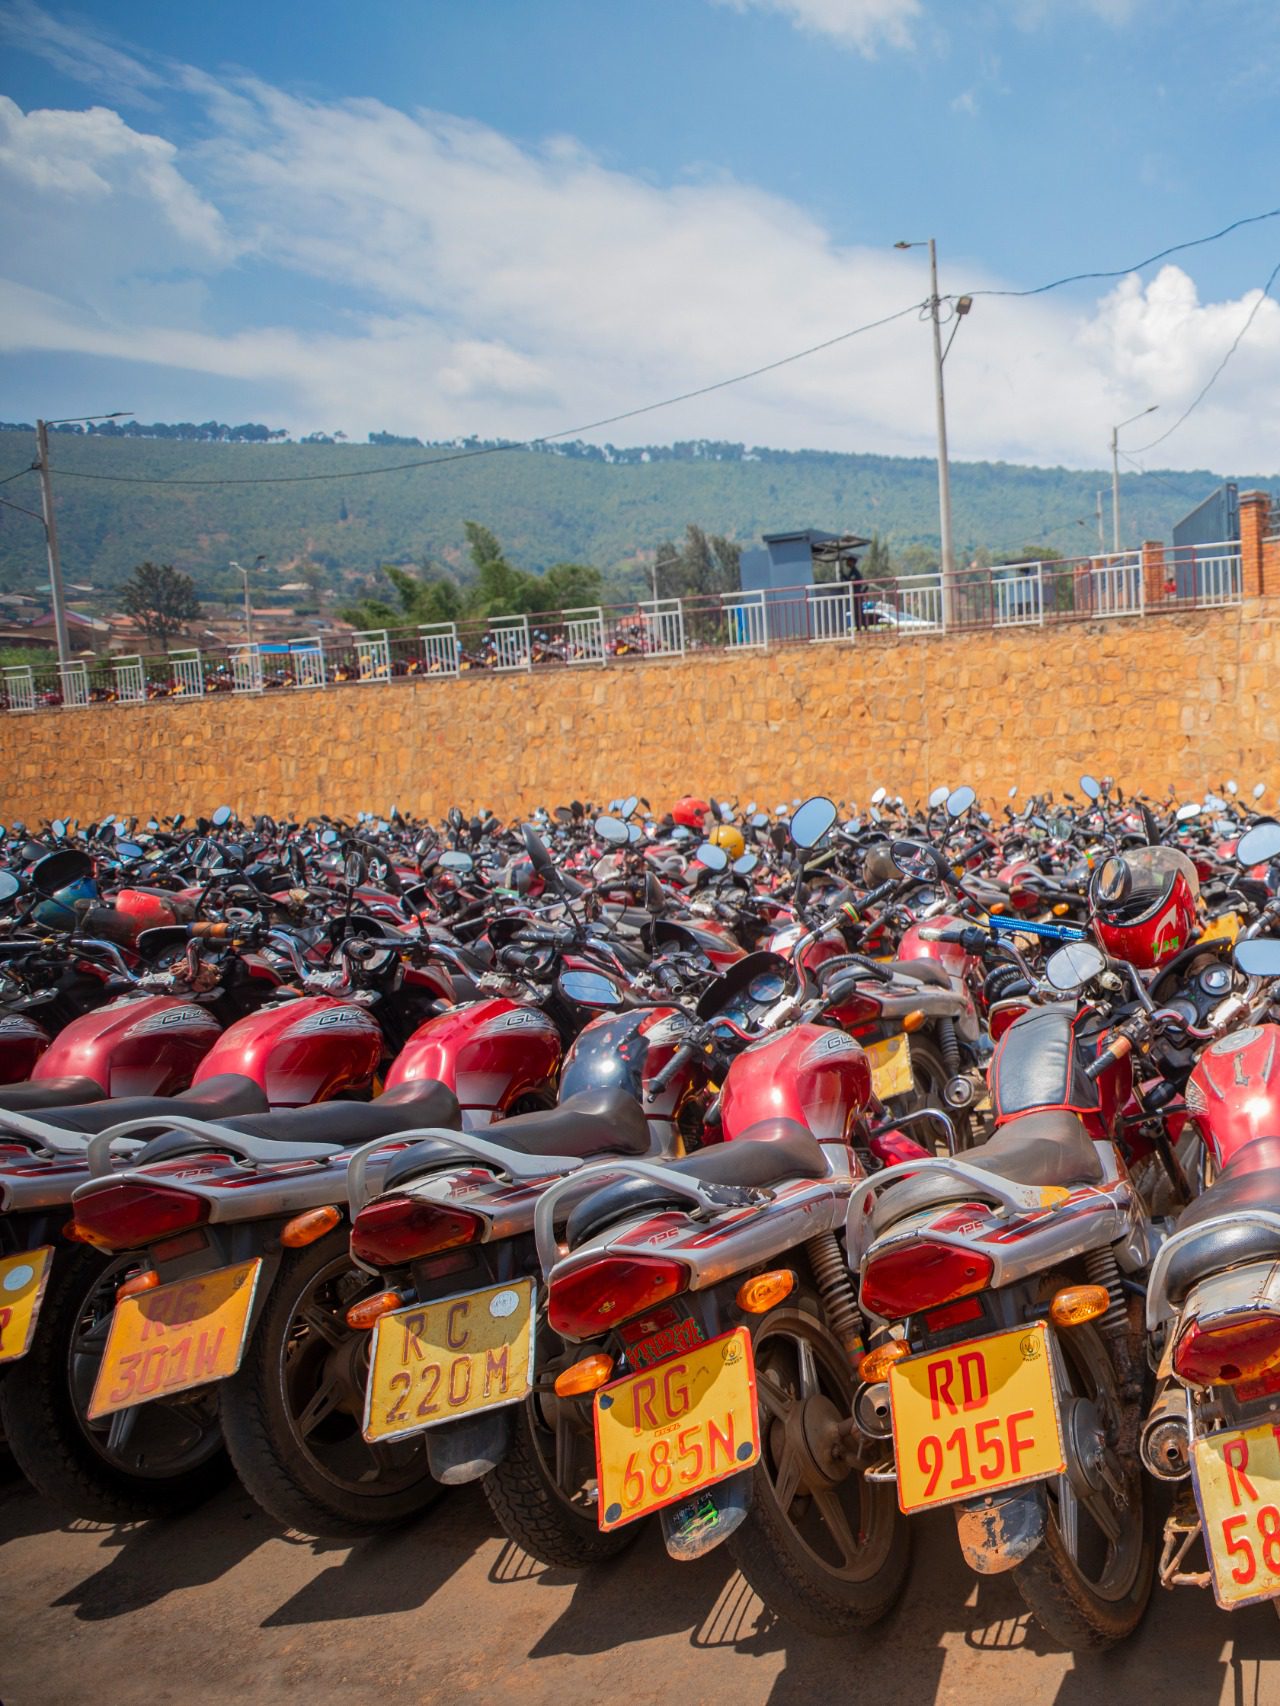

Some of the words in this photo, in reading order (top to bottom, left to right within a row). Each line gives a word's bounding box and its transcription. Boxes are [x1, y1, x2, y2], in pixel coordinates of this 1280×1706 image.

[648, 1226, 680, 1246] 125
[958, 1219, 984, 1236] 125
[141, 1283, 206, 1341] RG
[110, 1326, 227, 1404] 301W
[632, 1363, 690, 1436] RG
[927, 1350, 989, 1421] RD
[622, 1409, 737, 1508] 685N
[916, 1409, 1035, 1498] 915F
